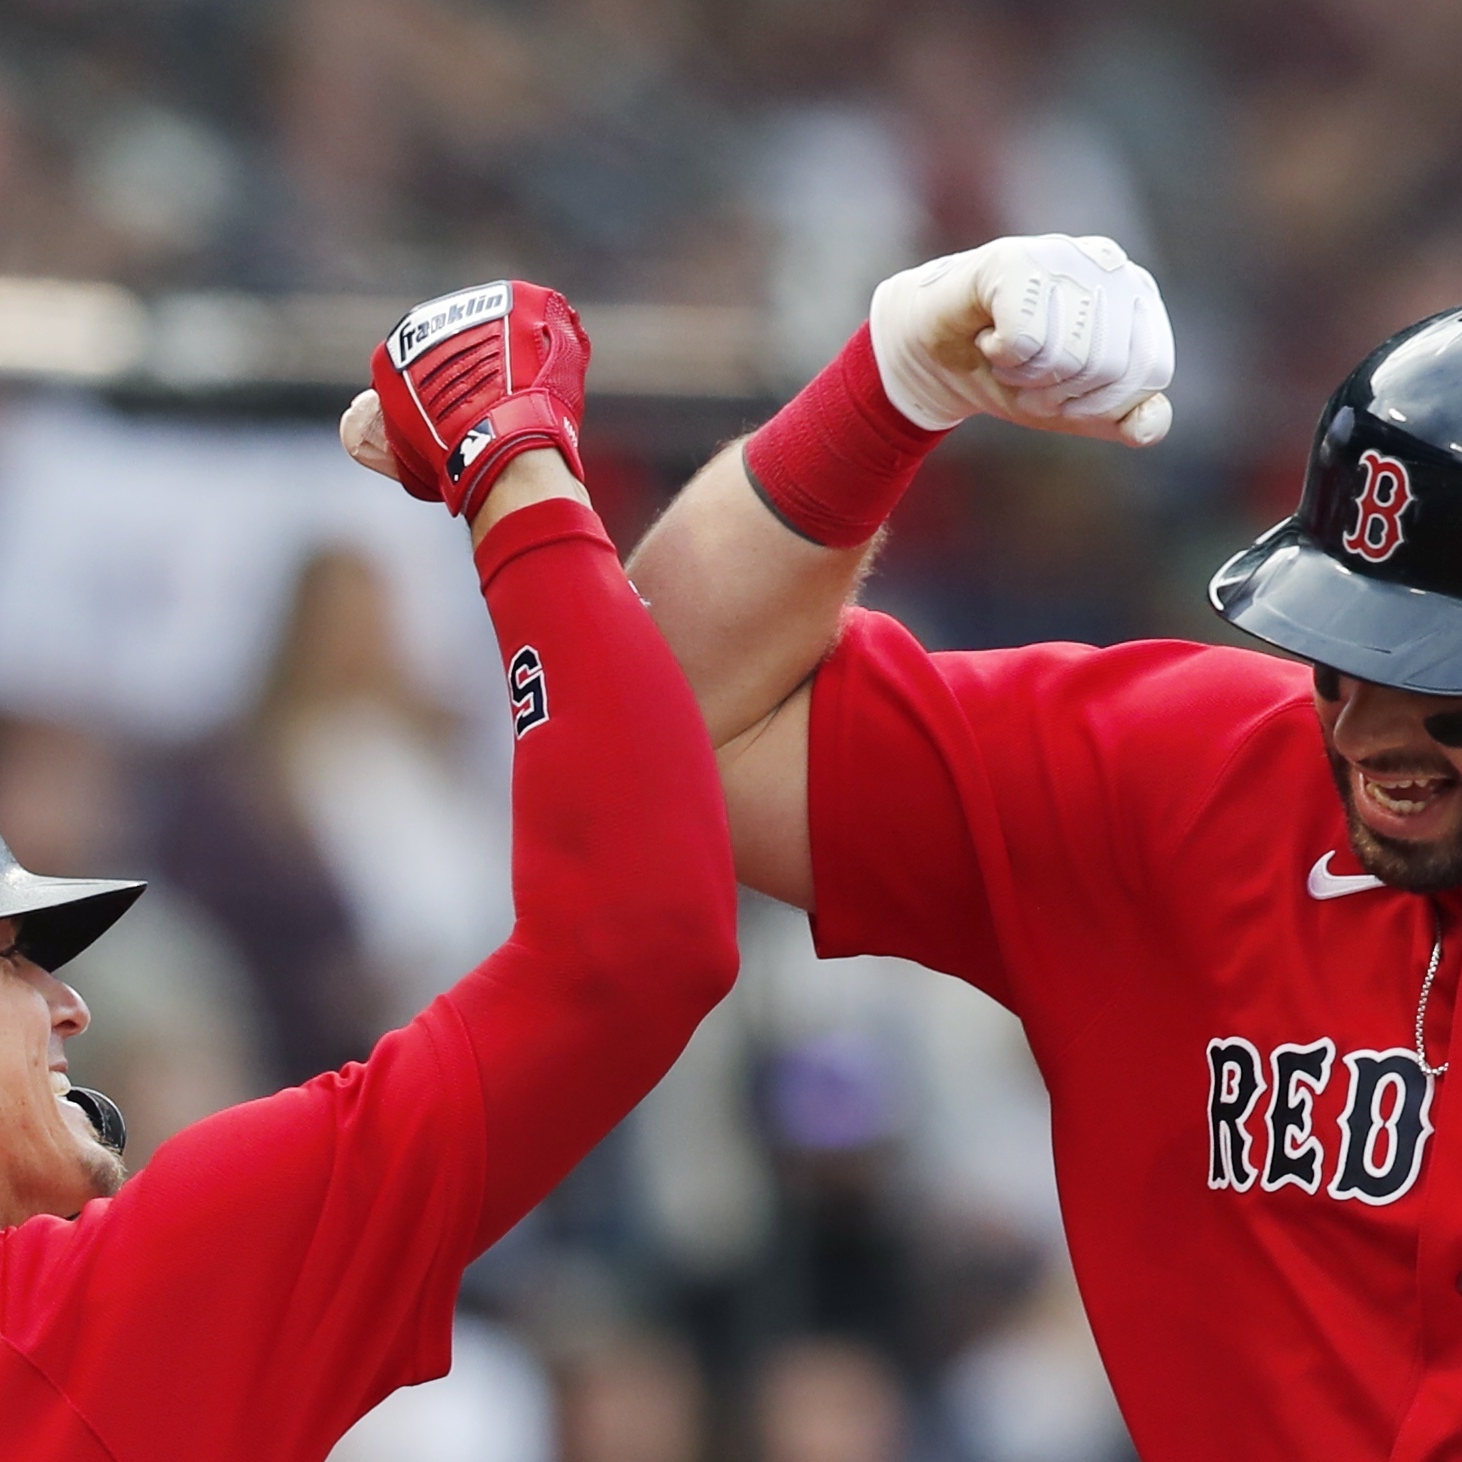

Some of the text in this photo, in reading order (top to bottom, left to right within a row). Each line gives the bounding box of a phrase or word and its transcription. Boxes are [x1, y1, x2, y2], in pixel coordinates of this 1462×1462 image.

[399, 294, 503, 363] franklin
[1342, 449, 1415, 563] B
[1206, 1037, 1435, 1206] RED
